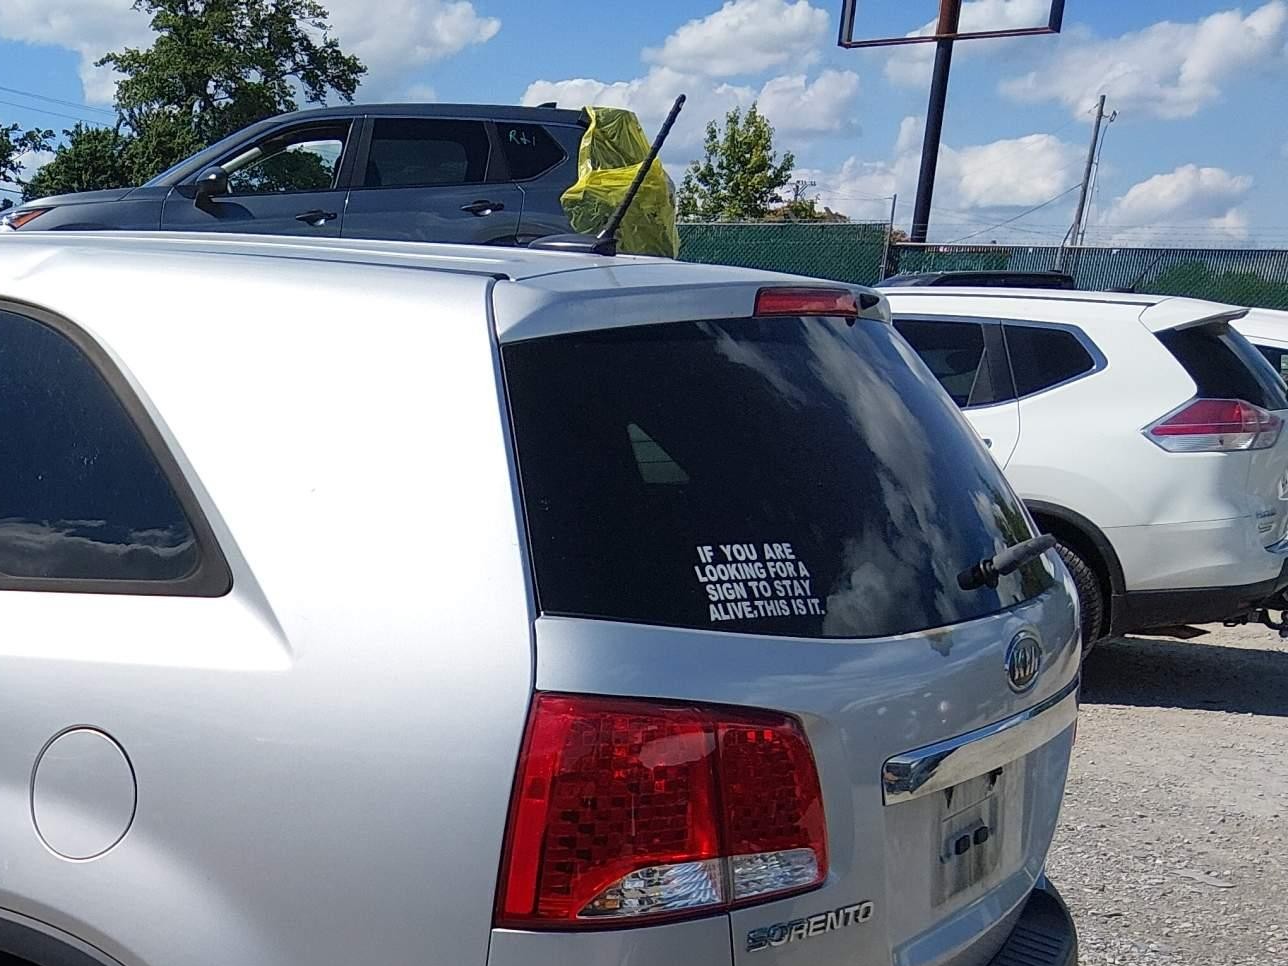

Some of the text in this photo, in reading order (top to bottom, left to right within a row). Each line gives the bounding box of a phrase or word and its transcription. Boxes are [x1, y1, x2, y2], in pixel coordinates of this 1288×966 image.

[696, 542, 796, 563] IF YOU ARE
[694, 560, 811, 583] LOOKING FOR A
[705, 579, 812, 602] SIGN TO STAY
[791, 598, 808, 616] IS
[807, 598, 826, 616] IT.
[746, 900, 874, 953] SORENTO
